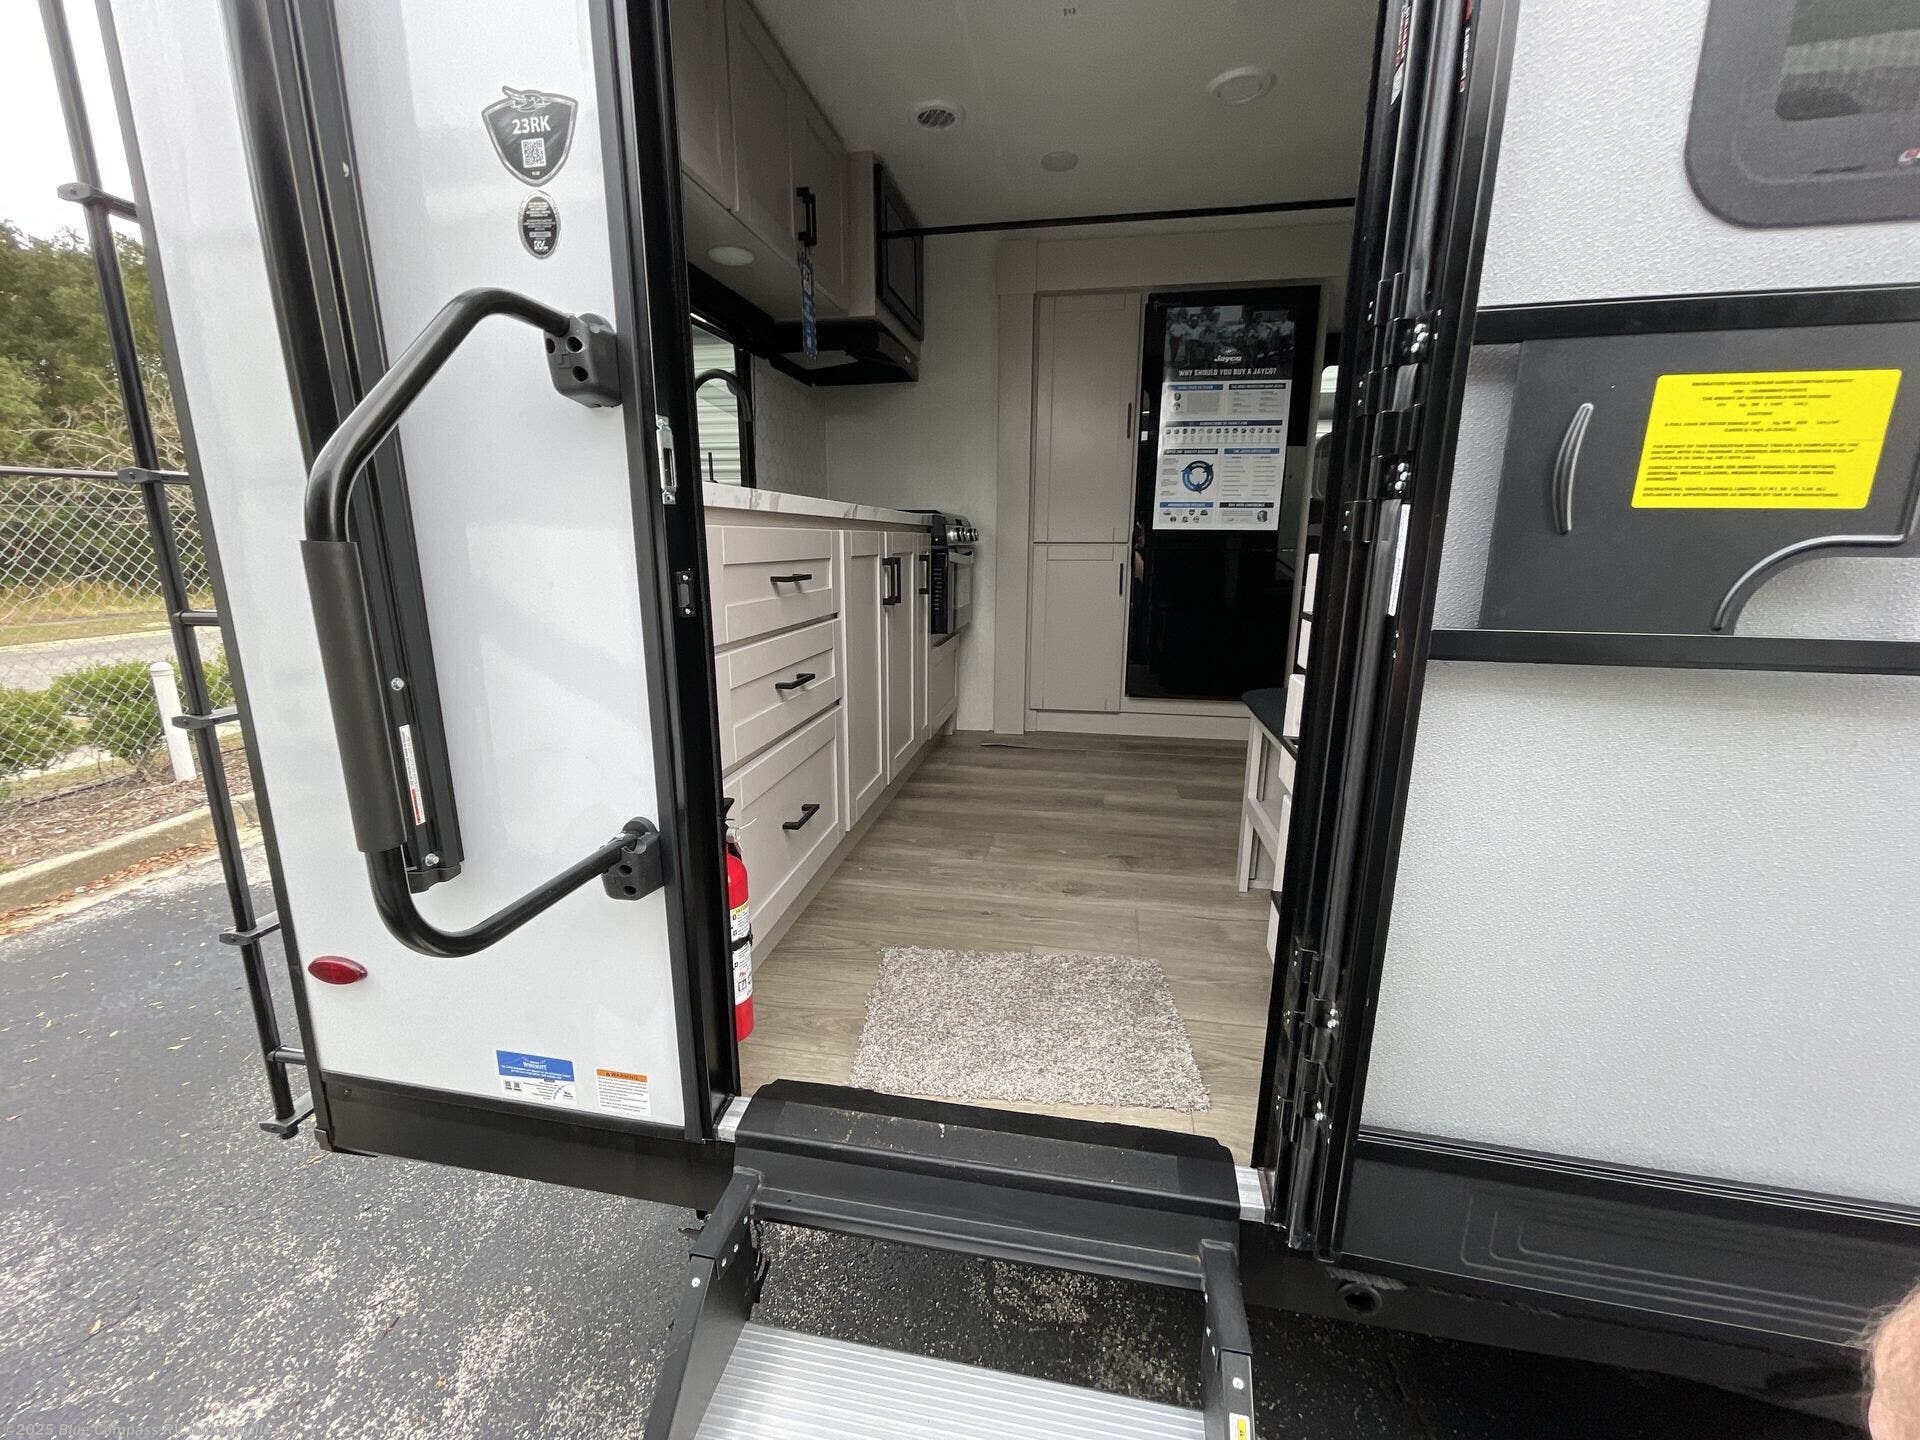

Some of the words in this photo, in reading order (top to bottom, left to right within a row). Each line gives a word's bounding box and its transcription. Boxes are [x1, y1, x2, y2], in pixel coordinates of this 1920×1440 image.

[512, 115, 551, 134] 23RK
[1213, 355, 1242, 363] Jayco
[1253, 367, 1277, 375] JAYCO?
